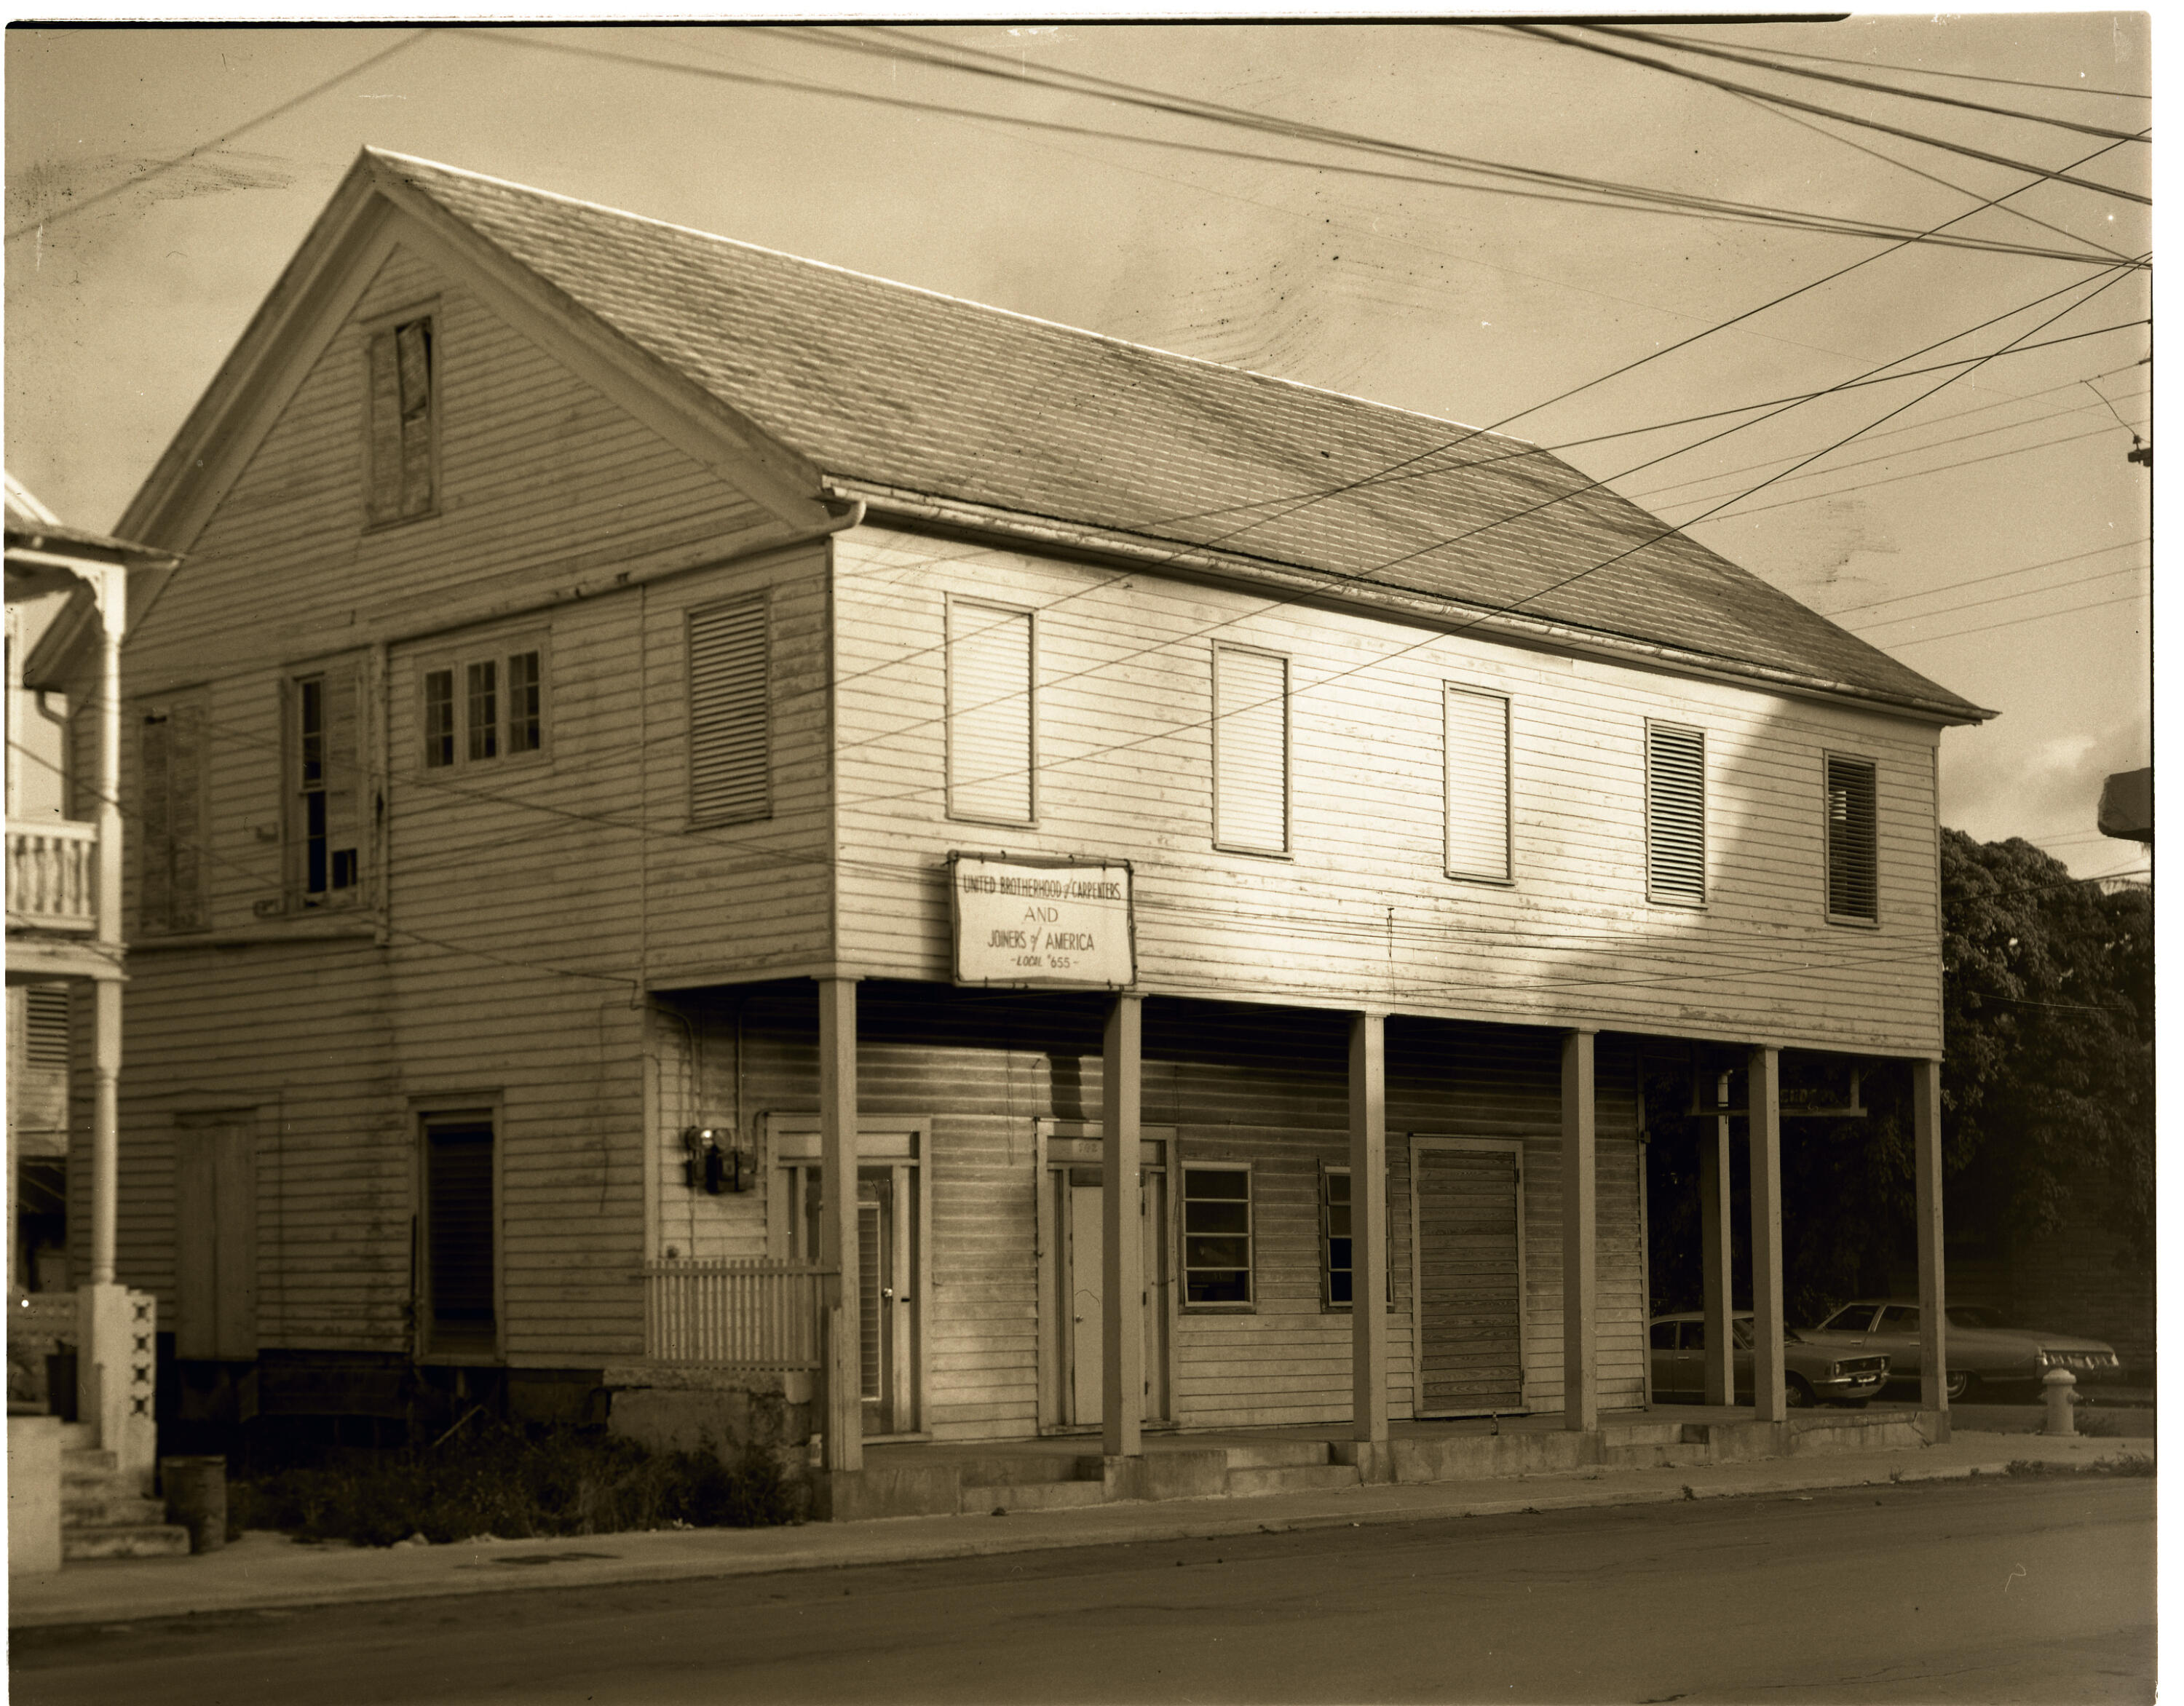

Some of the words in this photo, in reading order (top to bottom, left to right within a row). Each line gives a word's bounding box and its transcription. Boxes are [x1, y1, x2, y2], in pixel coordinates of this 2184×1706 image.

[963, 875, 996, 893] UNITED
[1000, 876, 1062, 897] BROTHERHOOD
[1072, 881, 1122, 900] CARPENTERS
[1024, 906, 1059, 924] AND
[987, 929, 1026, 949] JOINERS
[1045, 932, 1095, 951] AMERICA
